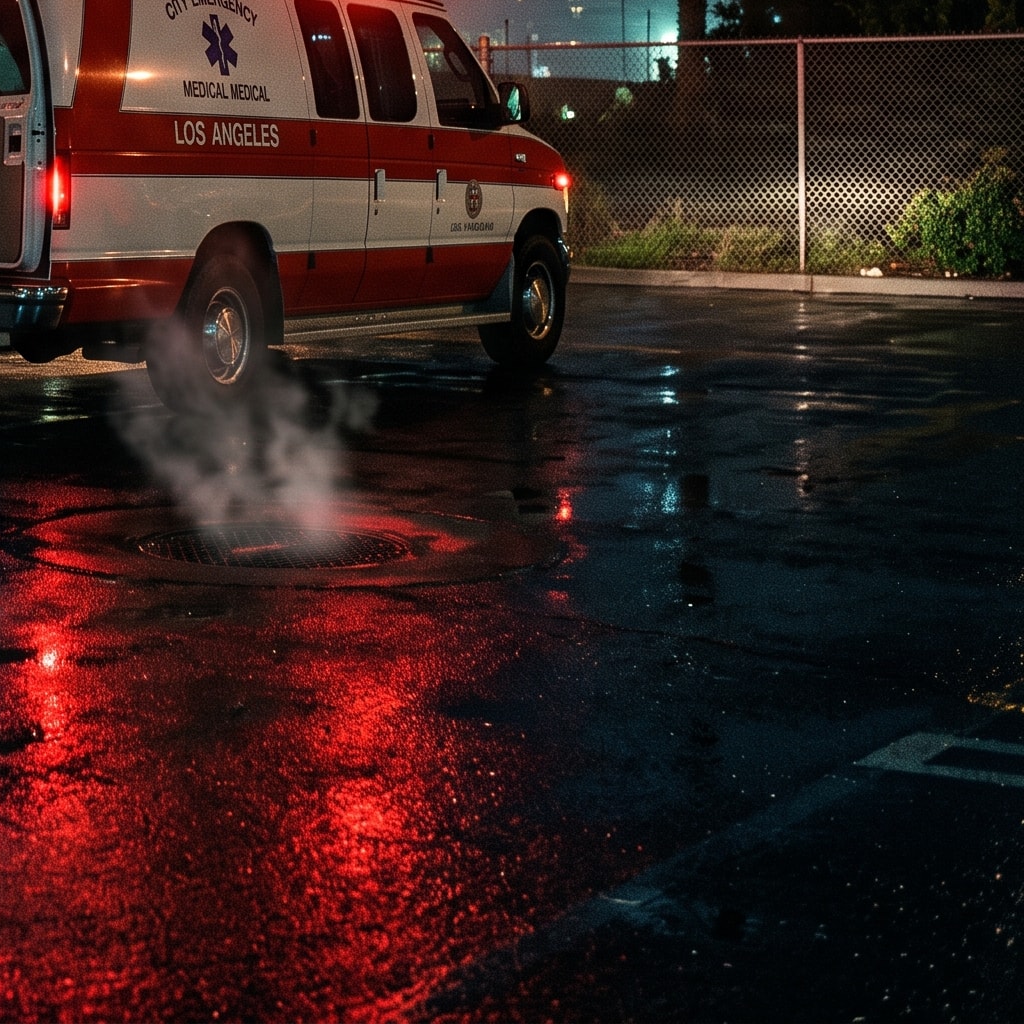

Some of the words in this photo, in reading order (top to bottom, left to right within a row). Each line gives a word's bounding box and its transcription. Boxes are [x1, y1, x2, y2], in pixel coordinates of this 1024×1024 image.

[183, 80, 229, 99] MEDICAL
[230, 83, 271, 102] MEDICAL
[174, 120, 206, 146] LOS
[212, 121, 280, 148] ANGELES
